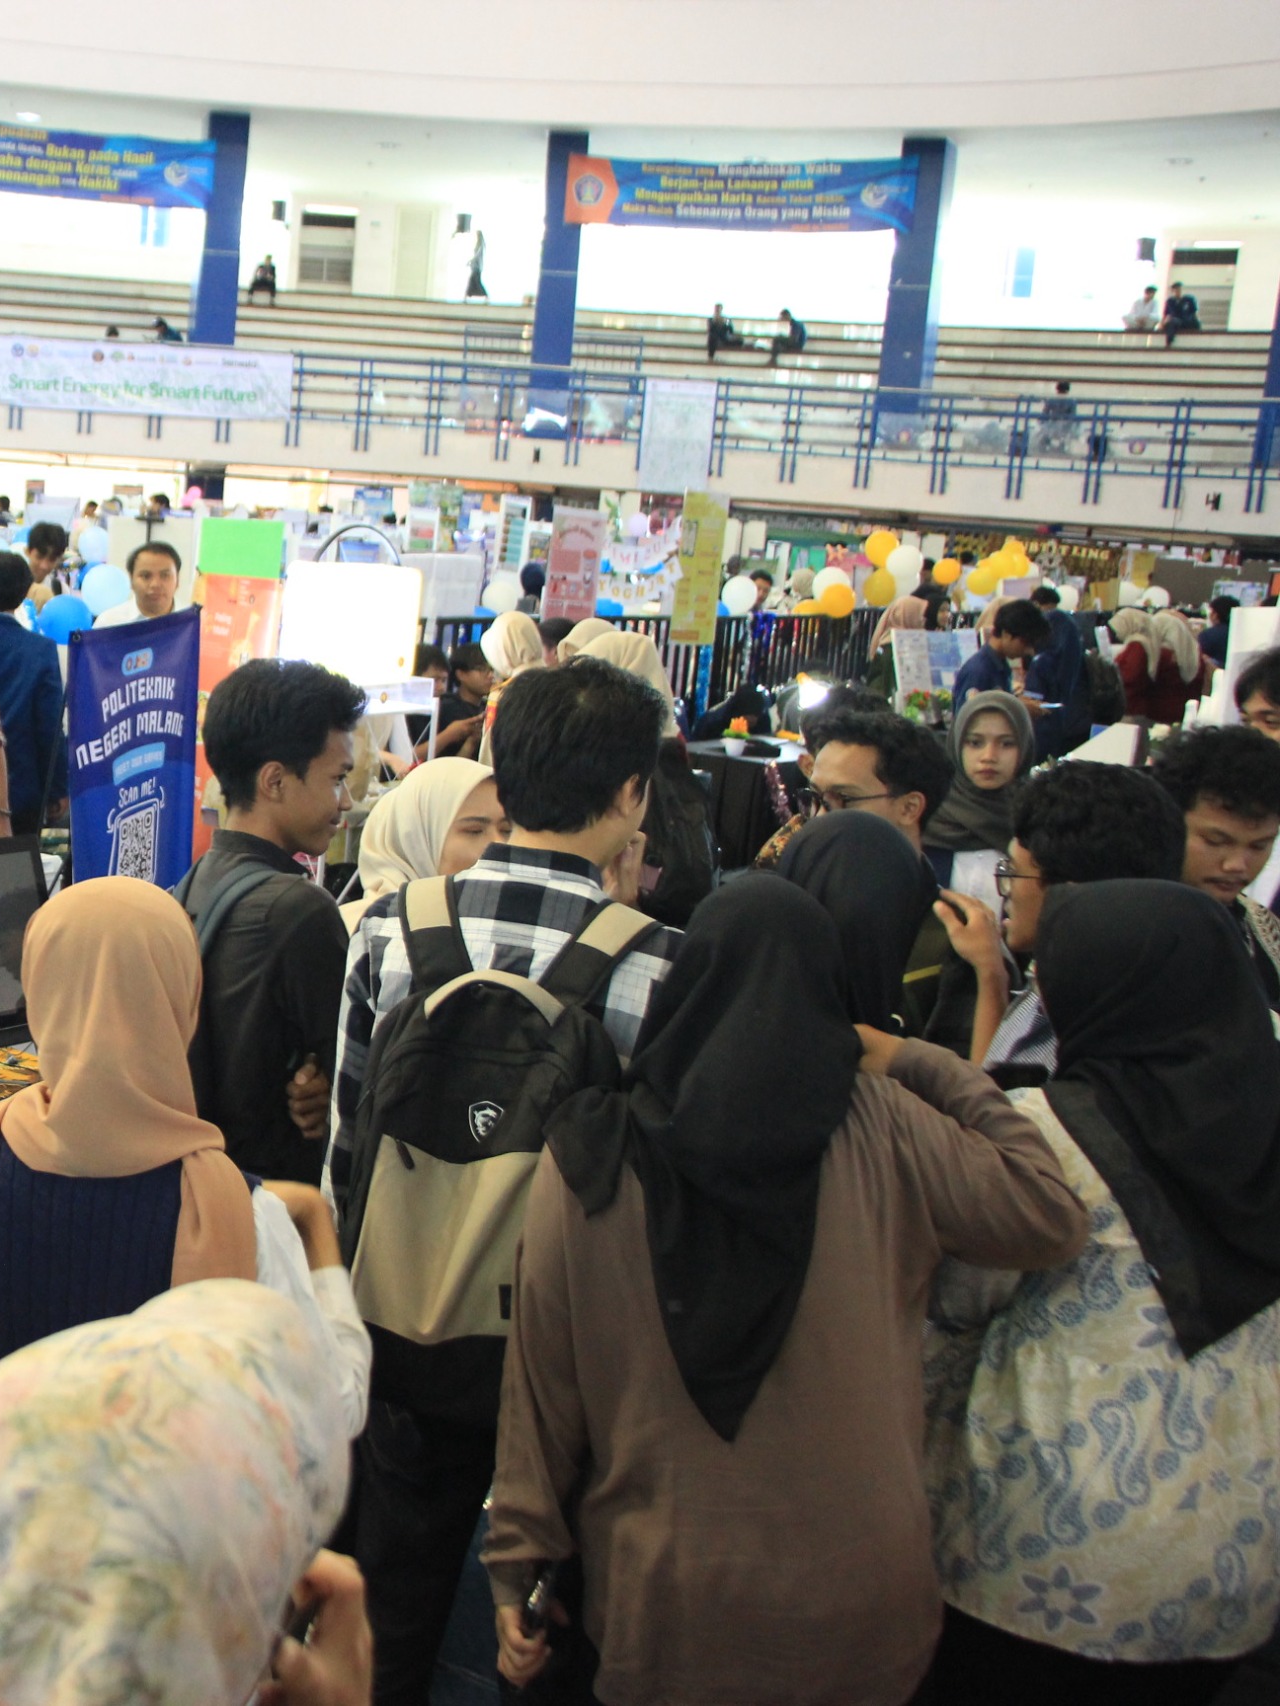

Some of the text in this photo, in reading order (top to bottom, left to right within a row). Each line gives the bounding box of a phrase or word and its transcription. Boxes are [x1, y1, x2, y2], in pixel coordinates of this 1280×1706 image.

[46, 143, 85, 160] Bukan
[88, 148, 119, 165] pada
[122, 150, 155, 166] Hasil
[26, 156, 73, 175] dengan
[76, 160, 111, 176] Keras
[718, 164, 801, 177] Menghabiskan
[805, 163, 842, 176] Waktu
[78, 175, 119, 191] Hakiki
[661, 175, 814, 193] Berjam-jam Lamanya untuk
[635, 188, 718, 204] Mengumpulkan
[721, 190, 753, 204] Harta
[676, 204, 741, 219] Sebenarnya
[744, 206, 778, 220] Orang
[781, 208, 809, 221] yang
[811, 205, 851, 219] Miskin
[8, 373, 258, 402] Smart Energy for Smart Future
[101, 676, 176, 723] POLITEKNIK
[75, 717, 132, 769] NEGERI
[136, 709, 184, 738] MALANG
